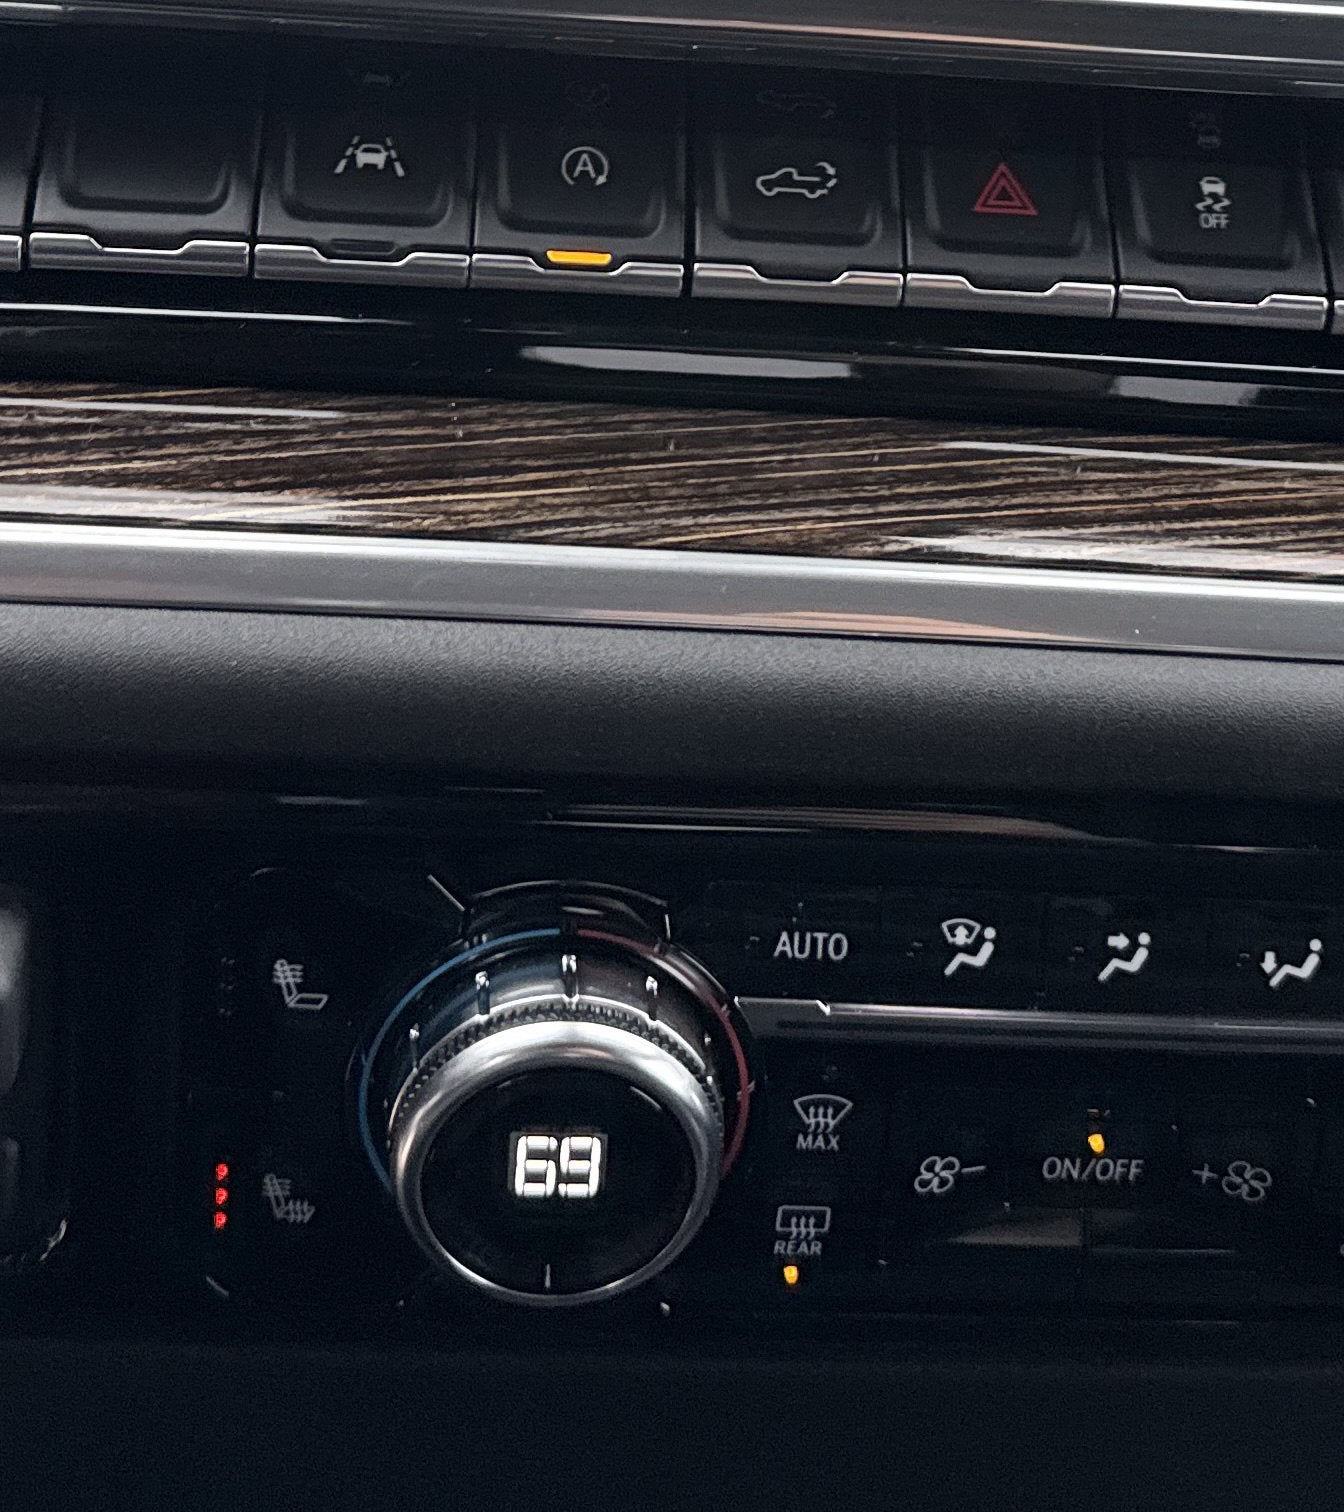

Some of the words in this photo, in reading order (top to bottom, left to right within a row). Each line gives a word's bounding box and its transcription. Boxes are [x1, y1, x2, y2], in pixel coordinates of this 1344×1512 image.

[1199, 212, 1231, 230] OFF
[774, 929, 849, 962] AUTO
[797, 1133, 840, 1152] MAX
[513, 1134, 603, 1199] 69
[1042, 1156, 1144, 1183] ON/OFF
[774, 1239, 822, 1256] REAR
